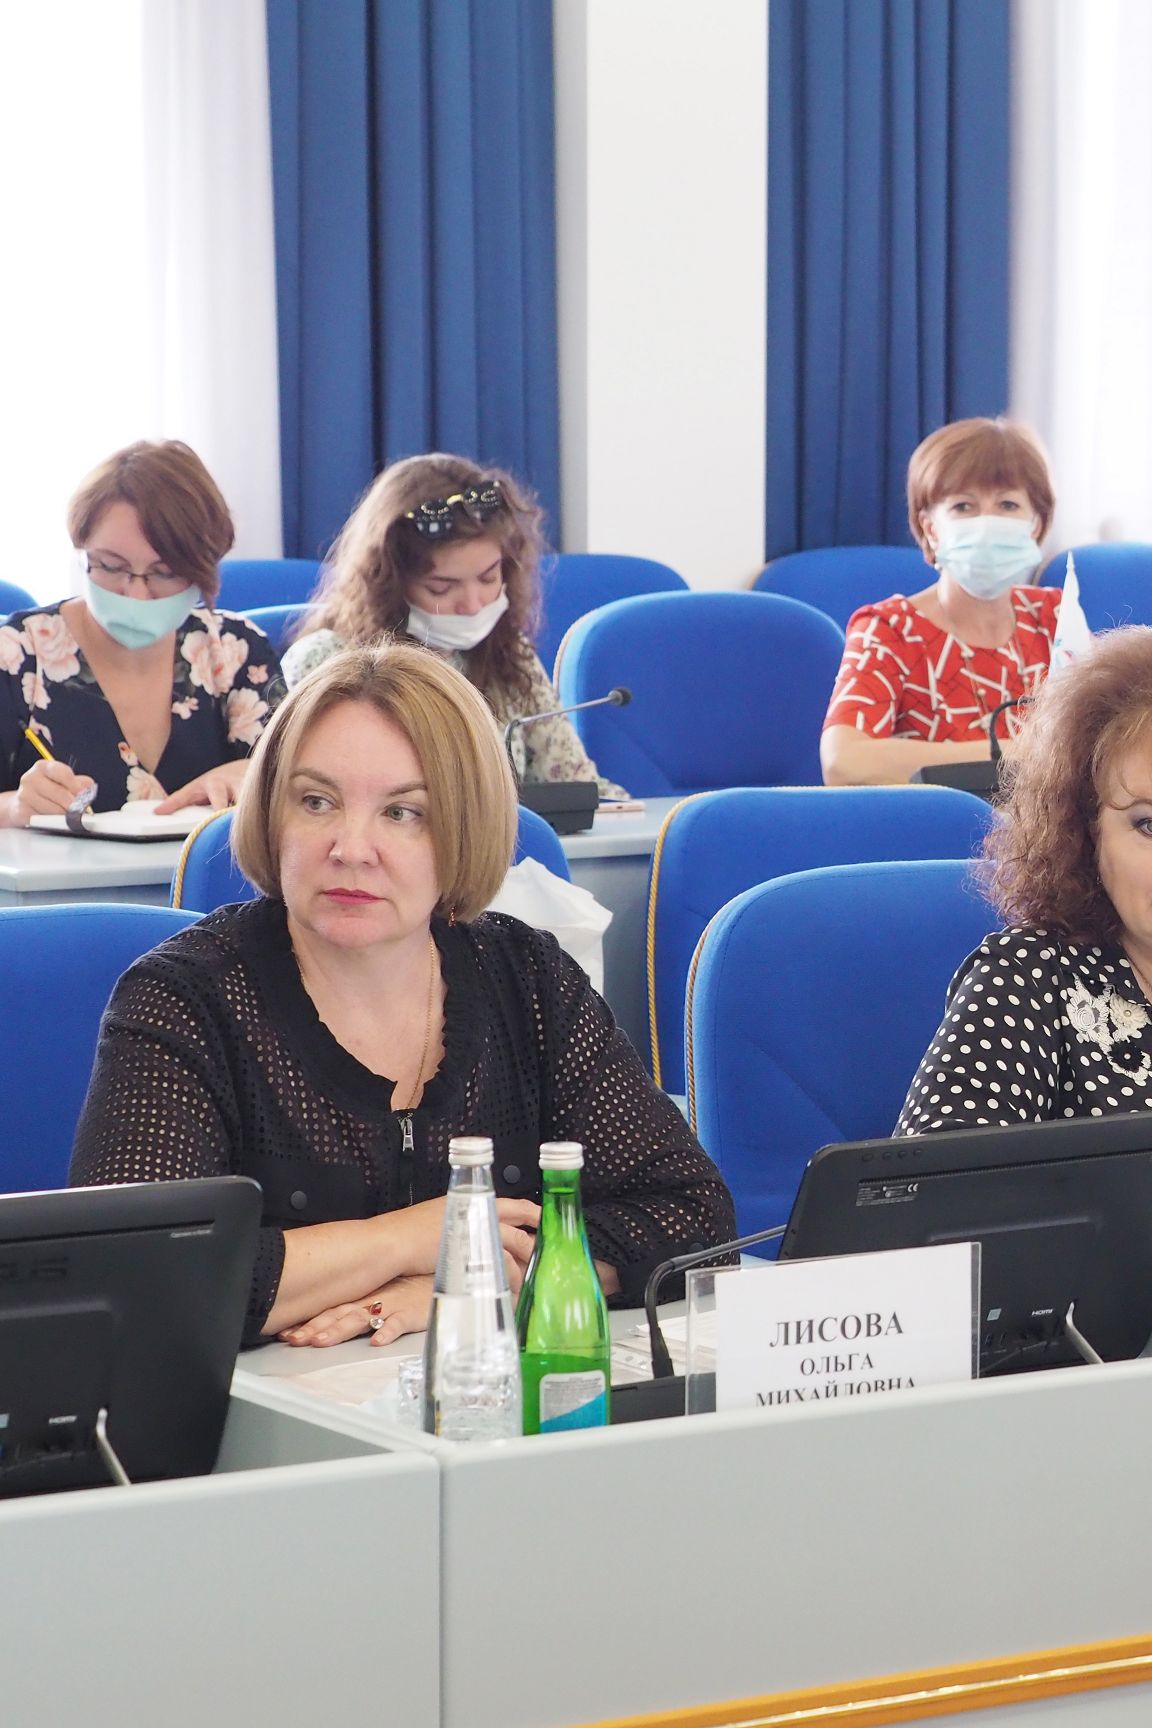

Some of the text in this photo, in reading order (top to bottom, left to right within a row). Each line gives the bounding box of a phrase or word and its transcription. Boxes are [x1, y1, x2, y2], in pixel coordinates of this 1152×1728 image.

[769, 1311, 904, 1348] ЛИСОВА
[799, 1352, 875, 1377] ОЛЬГА
[755, 1376, 916, 1407] МИХАЙЛОВНА
